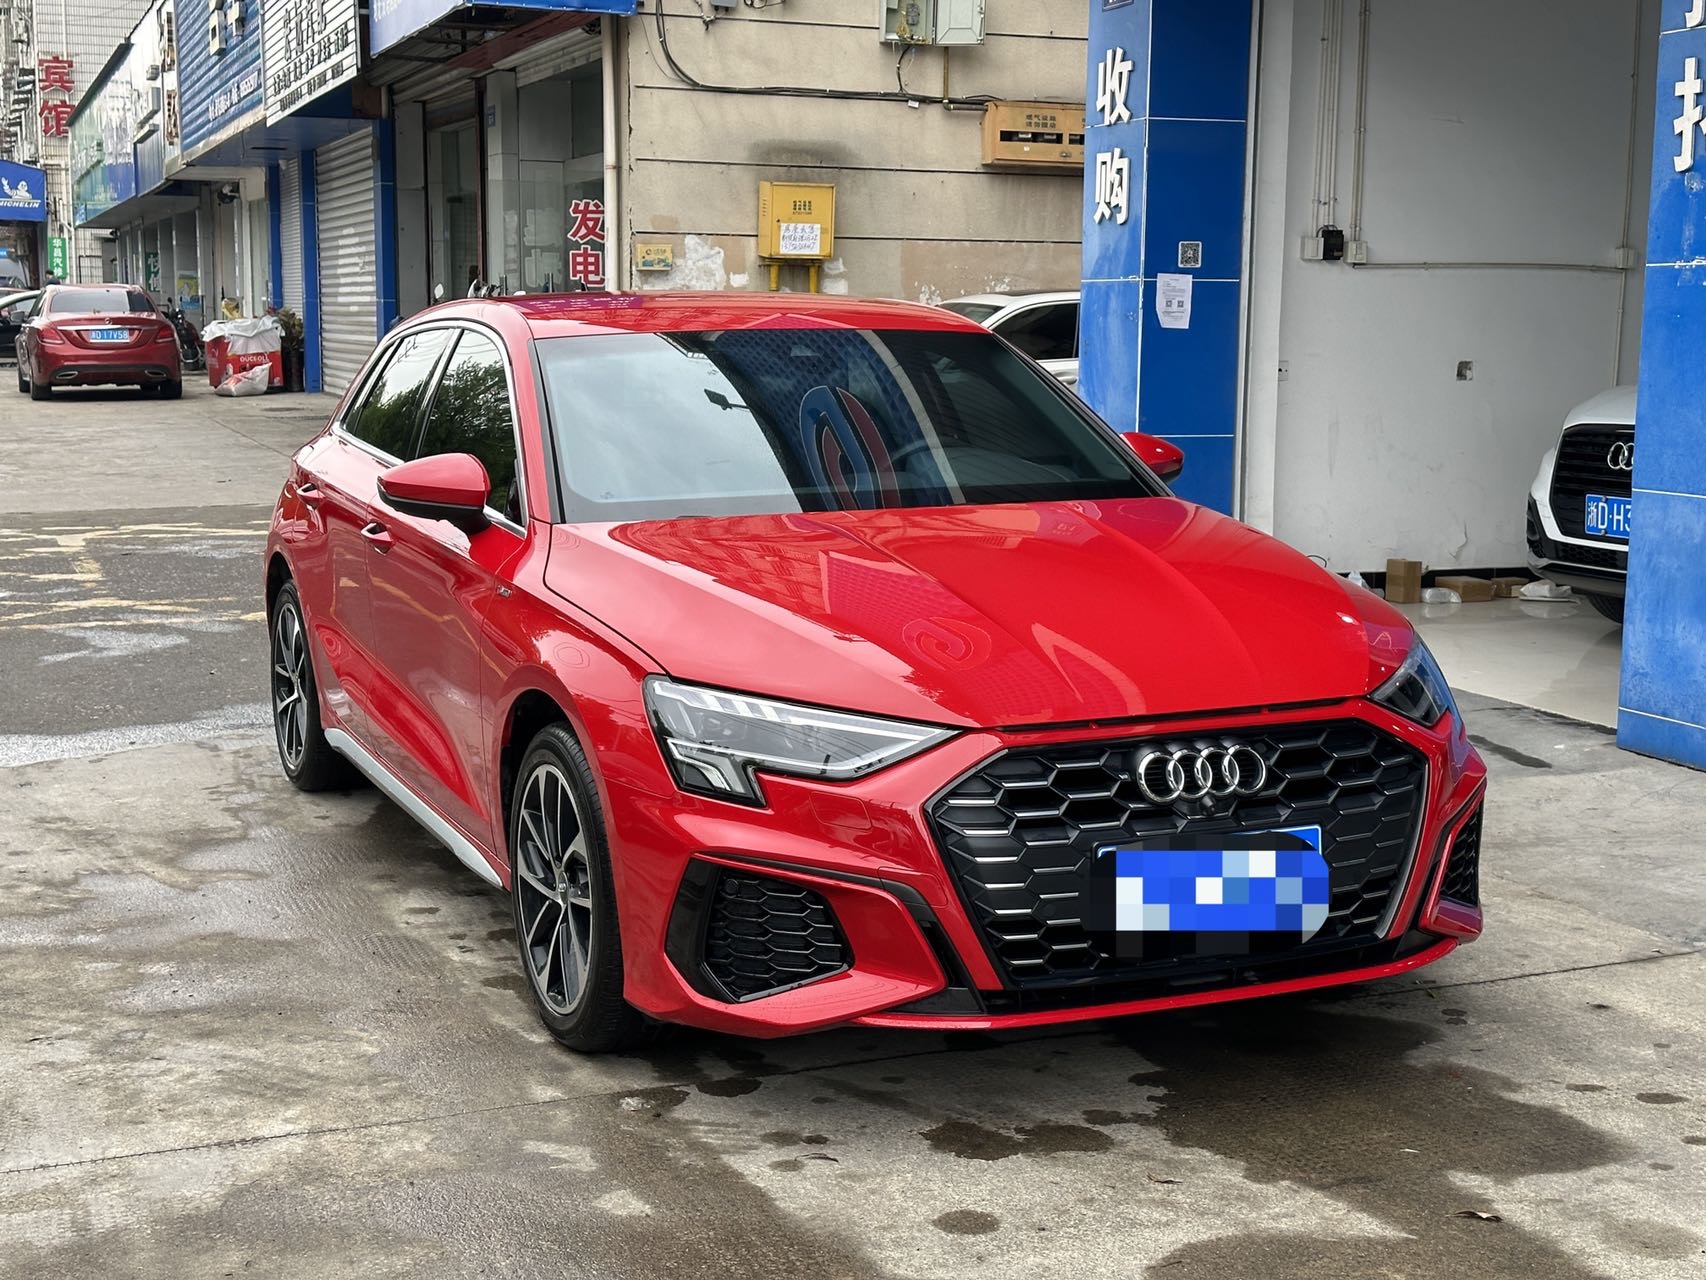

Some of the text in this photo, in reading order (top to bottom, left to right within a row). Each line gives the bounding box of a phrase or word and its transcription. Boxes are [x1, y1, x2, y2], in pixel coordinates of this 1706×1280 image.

[38, 55, 76, 137] 宾馆
[1093, 47, 1133, 225] 收购
[567, 199, 606, 287] 发电
